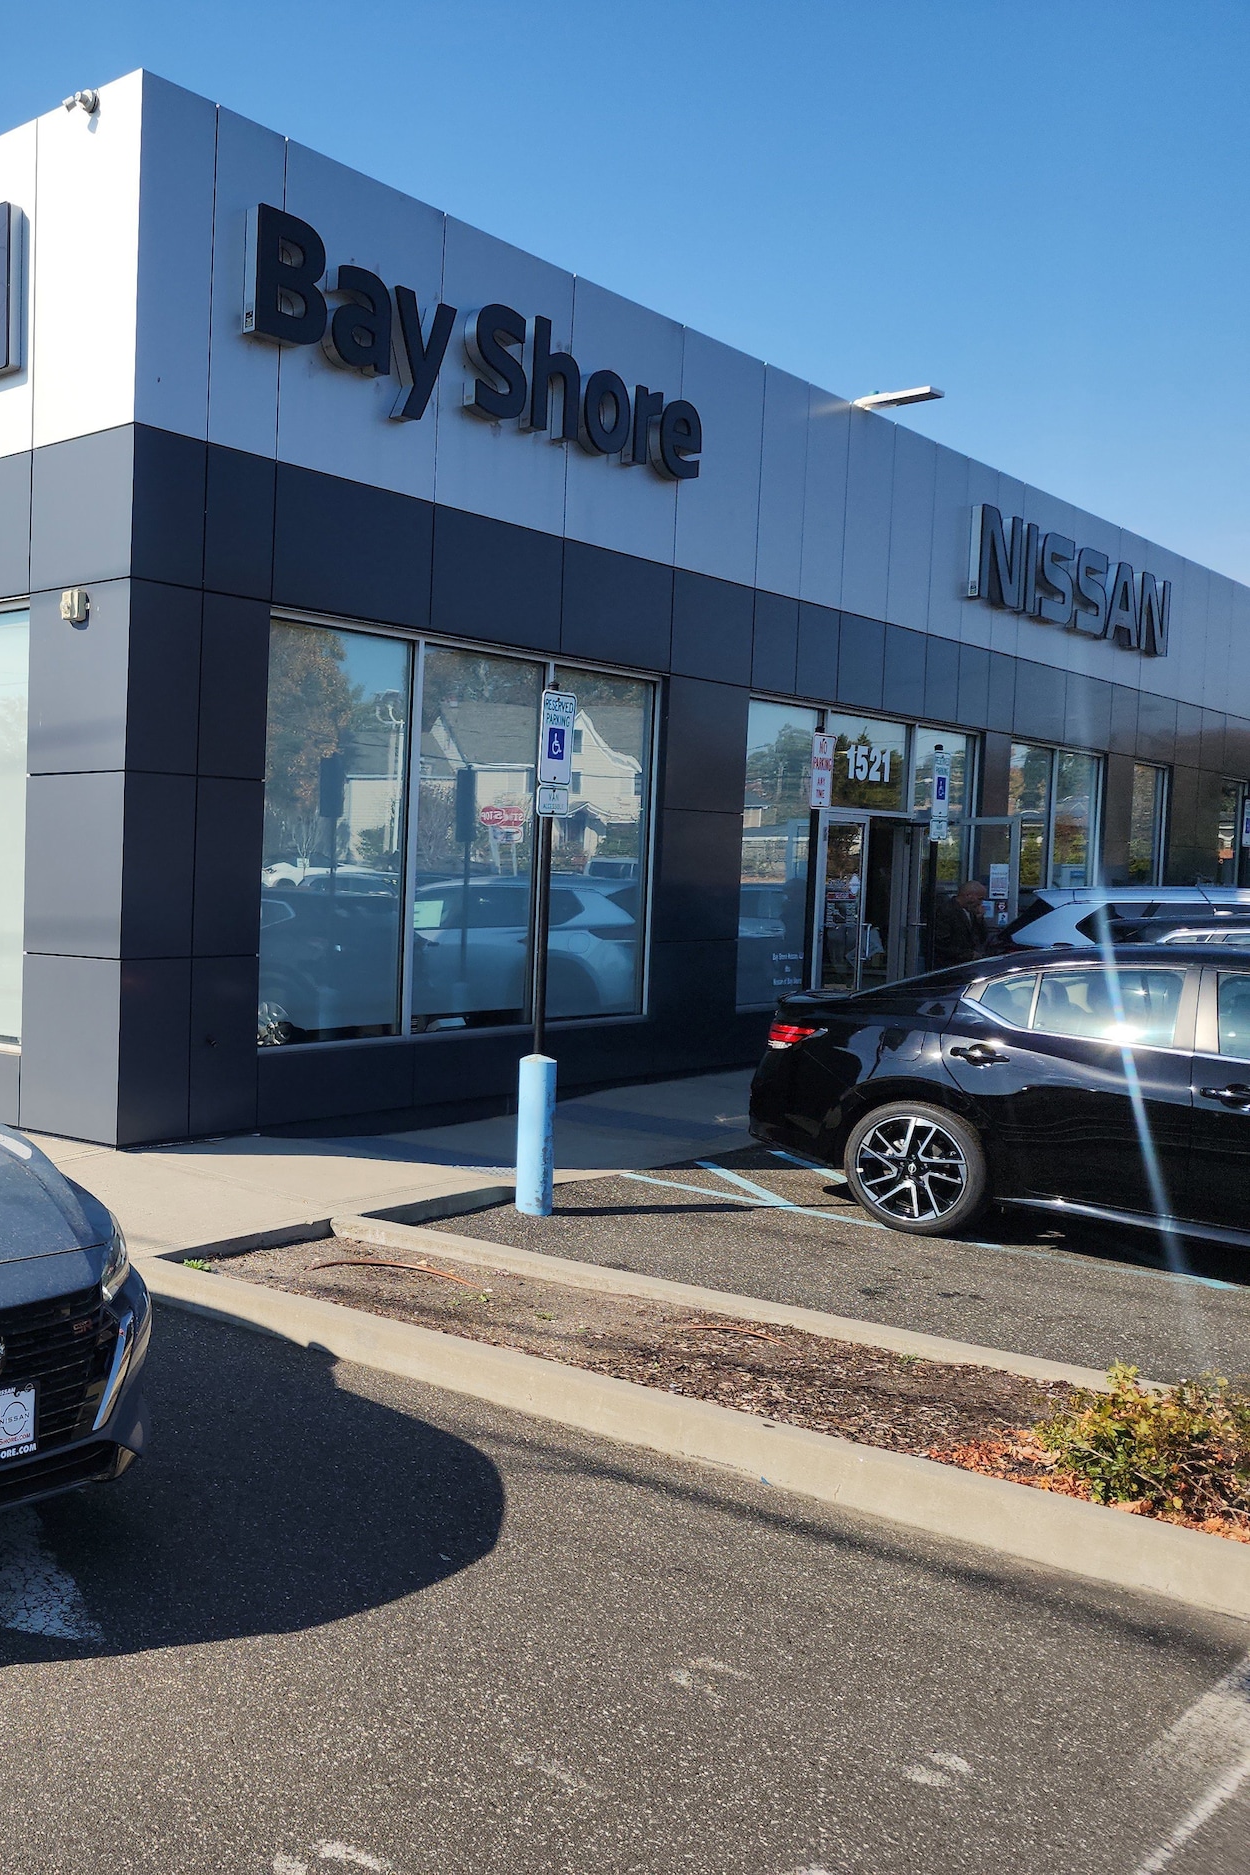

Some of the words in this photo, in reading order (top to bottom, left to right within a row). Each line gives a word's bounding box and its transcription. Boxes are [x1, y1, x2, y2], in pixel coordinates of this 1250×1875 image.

[244, 202, 458, 422] Bay
[463, 303, 703, 481] Shore
[968, 503, 1171, 657] NISSAN
[544, 698, 574, 714] RESERVED
[546, 712, 571, 728] PARKING
[819, 740, 828, 754] NO
[812, 756, 832, 771] PARKING
[847, 744, 891, 782] 1521
[72, 1319, 92, 1335] SR
[0, 1412, 30, 1425] NISSAN
